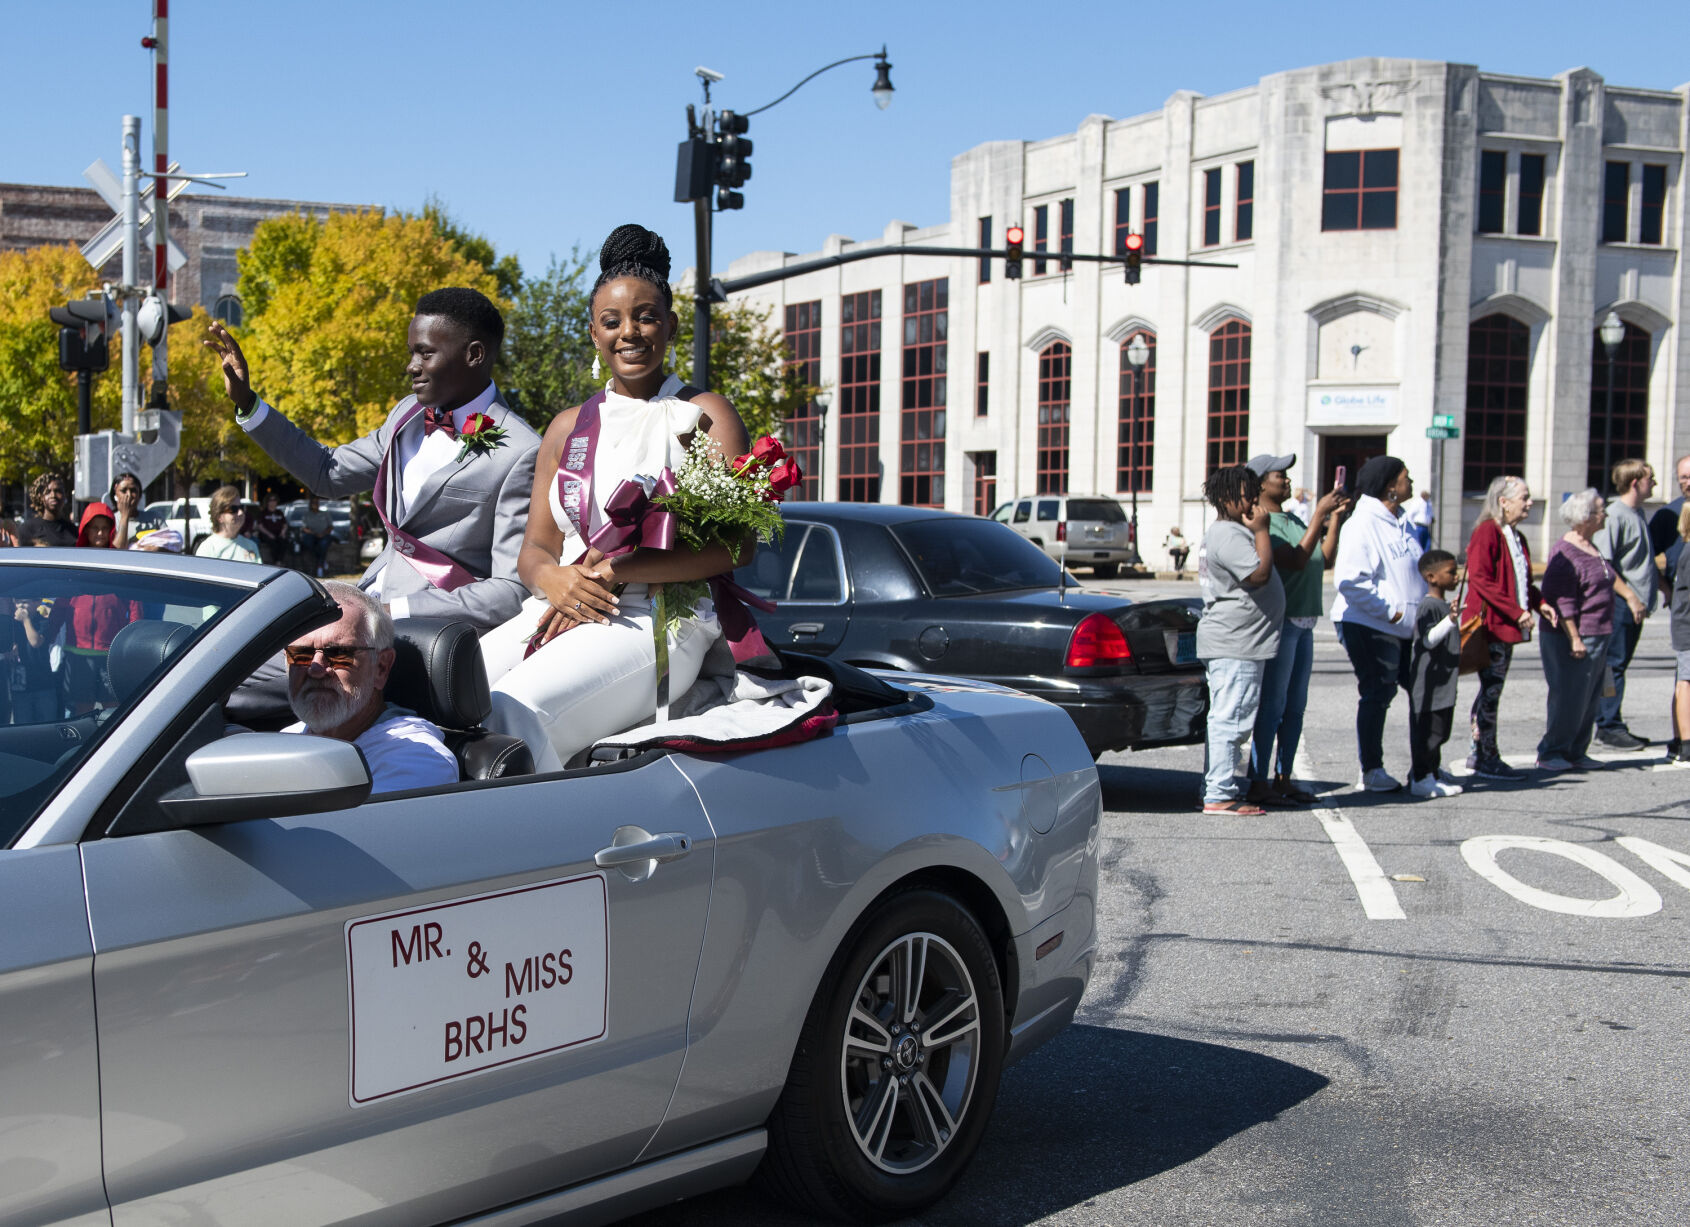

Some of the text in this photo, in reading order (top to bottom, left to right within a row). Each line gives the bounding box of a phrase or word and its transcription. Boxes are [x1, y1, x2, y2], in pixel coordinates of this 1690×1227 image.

[1367, 393, 1386, 406] Life
[565, 436, 589, 471] MISS
[391, 922, 573, 998] MR. & MISS
[444, 1003, 528, 1063] BRHS
